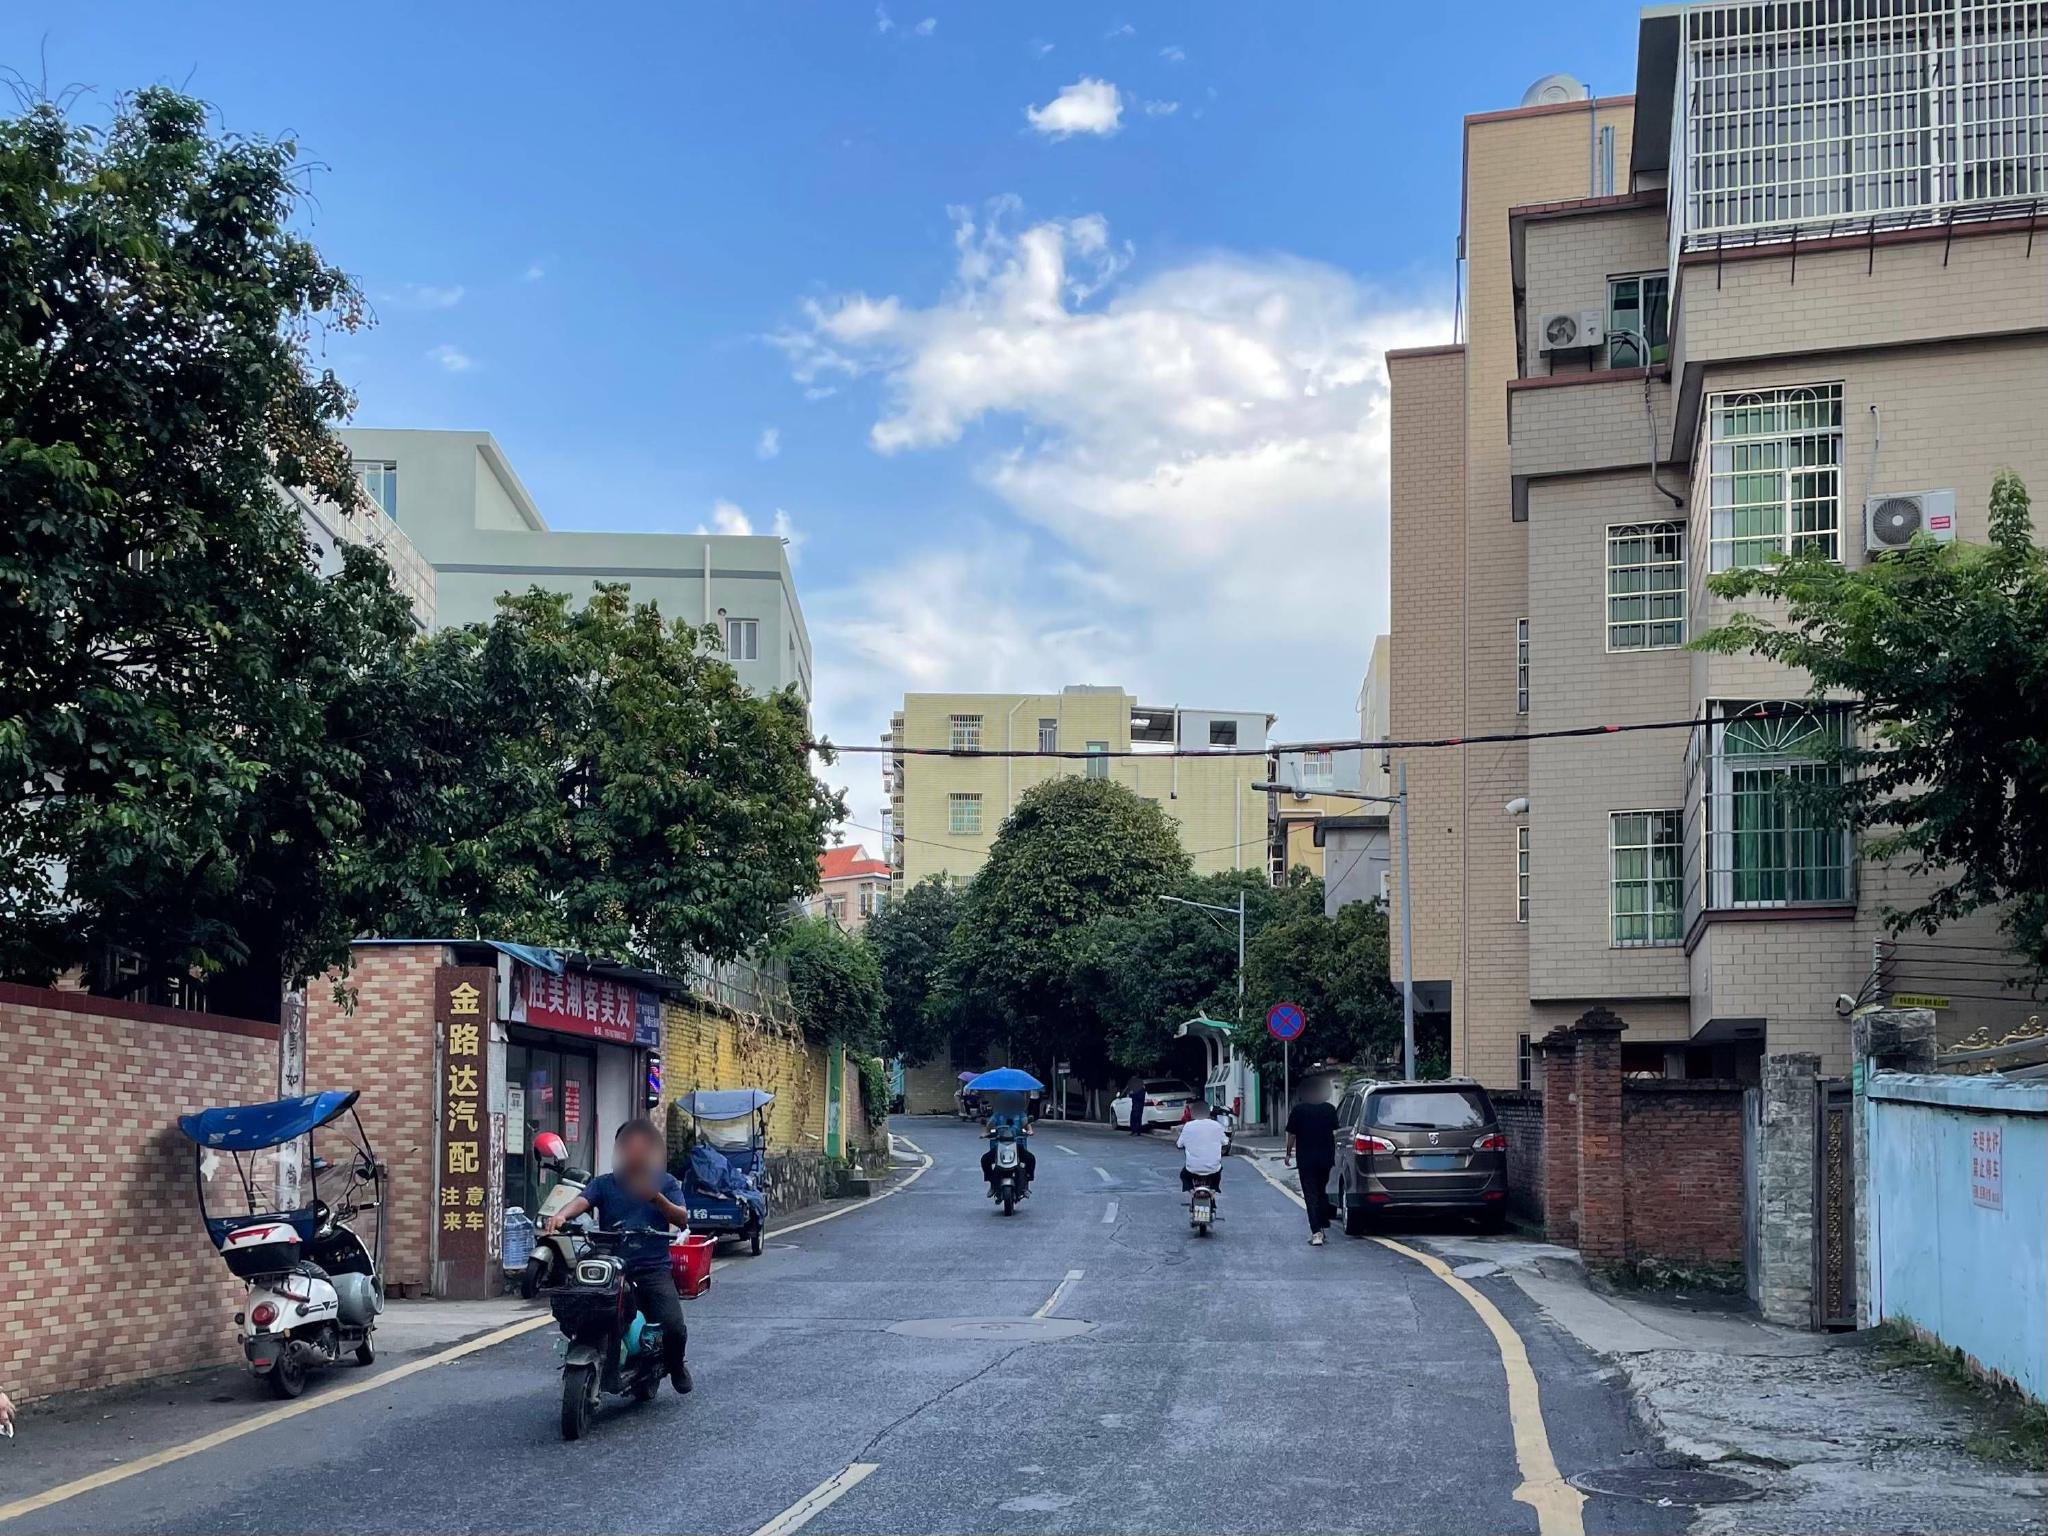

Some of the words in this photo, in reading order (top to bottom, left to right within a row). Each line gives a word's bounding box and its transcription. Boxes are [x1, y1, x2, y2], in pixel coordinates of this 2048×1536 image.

[448, 982, 480, 1174] 金路达汽配
[441, 1187, 485, 1206] 注意
[443, 1211, 484, 1231] 来车
